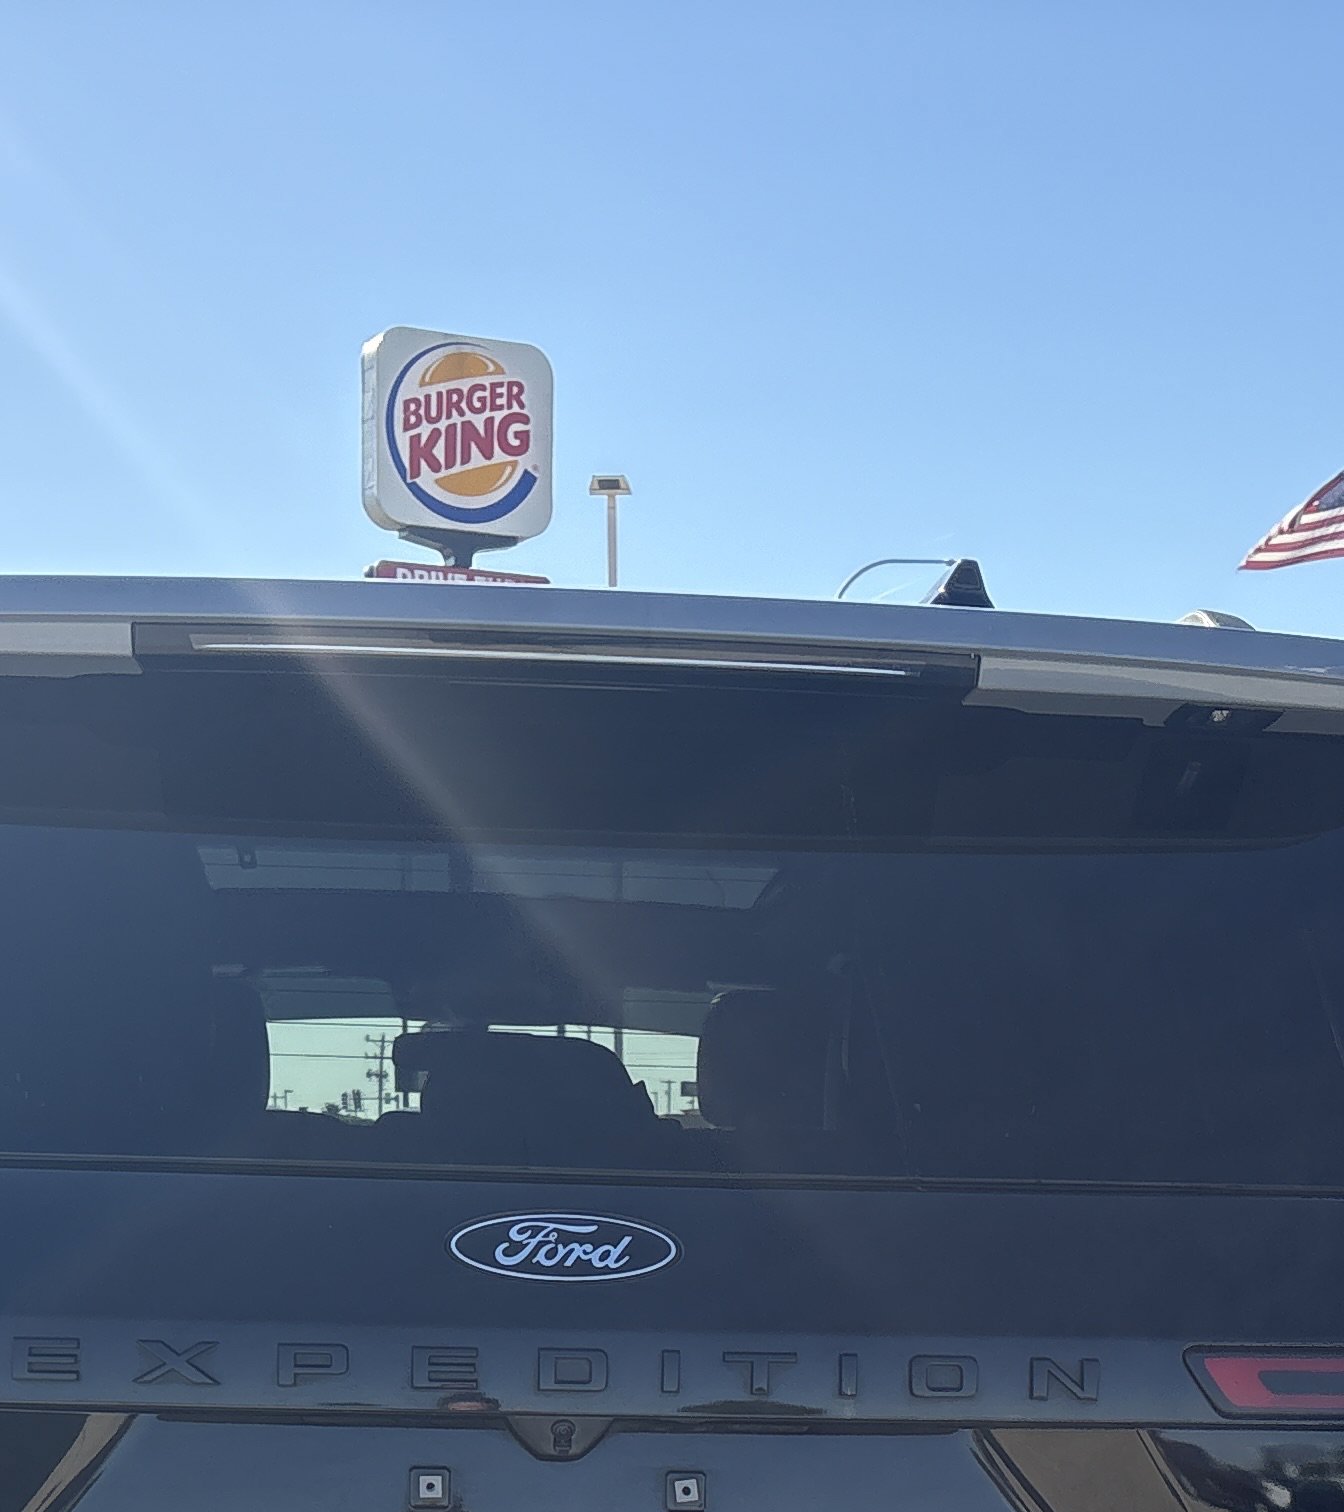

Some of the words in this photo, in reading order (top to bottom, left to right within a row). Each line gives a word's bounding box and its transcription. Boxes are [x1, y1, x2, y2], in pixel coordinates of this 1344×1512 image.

[402, 381, 525, 432] BURGER
[409, 412, 531, 480] KING
[495, 1221, 633, 1269] Ford
[12, 1336, 1101, 1401] EXPEDITION
